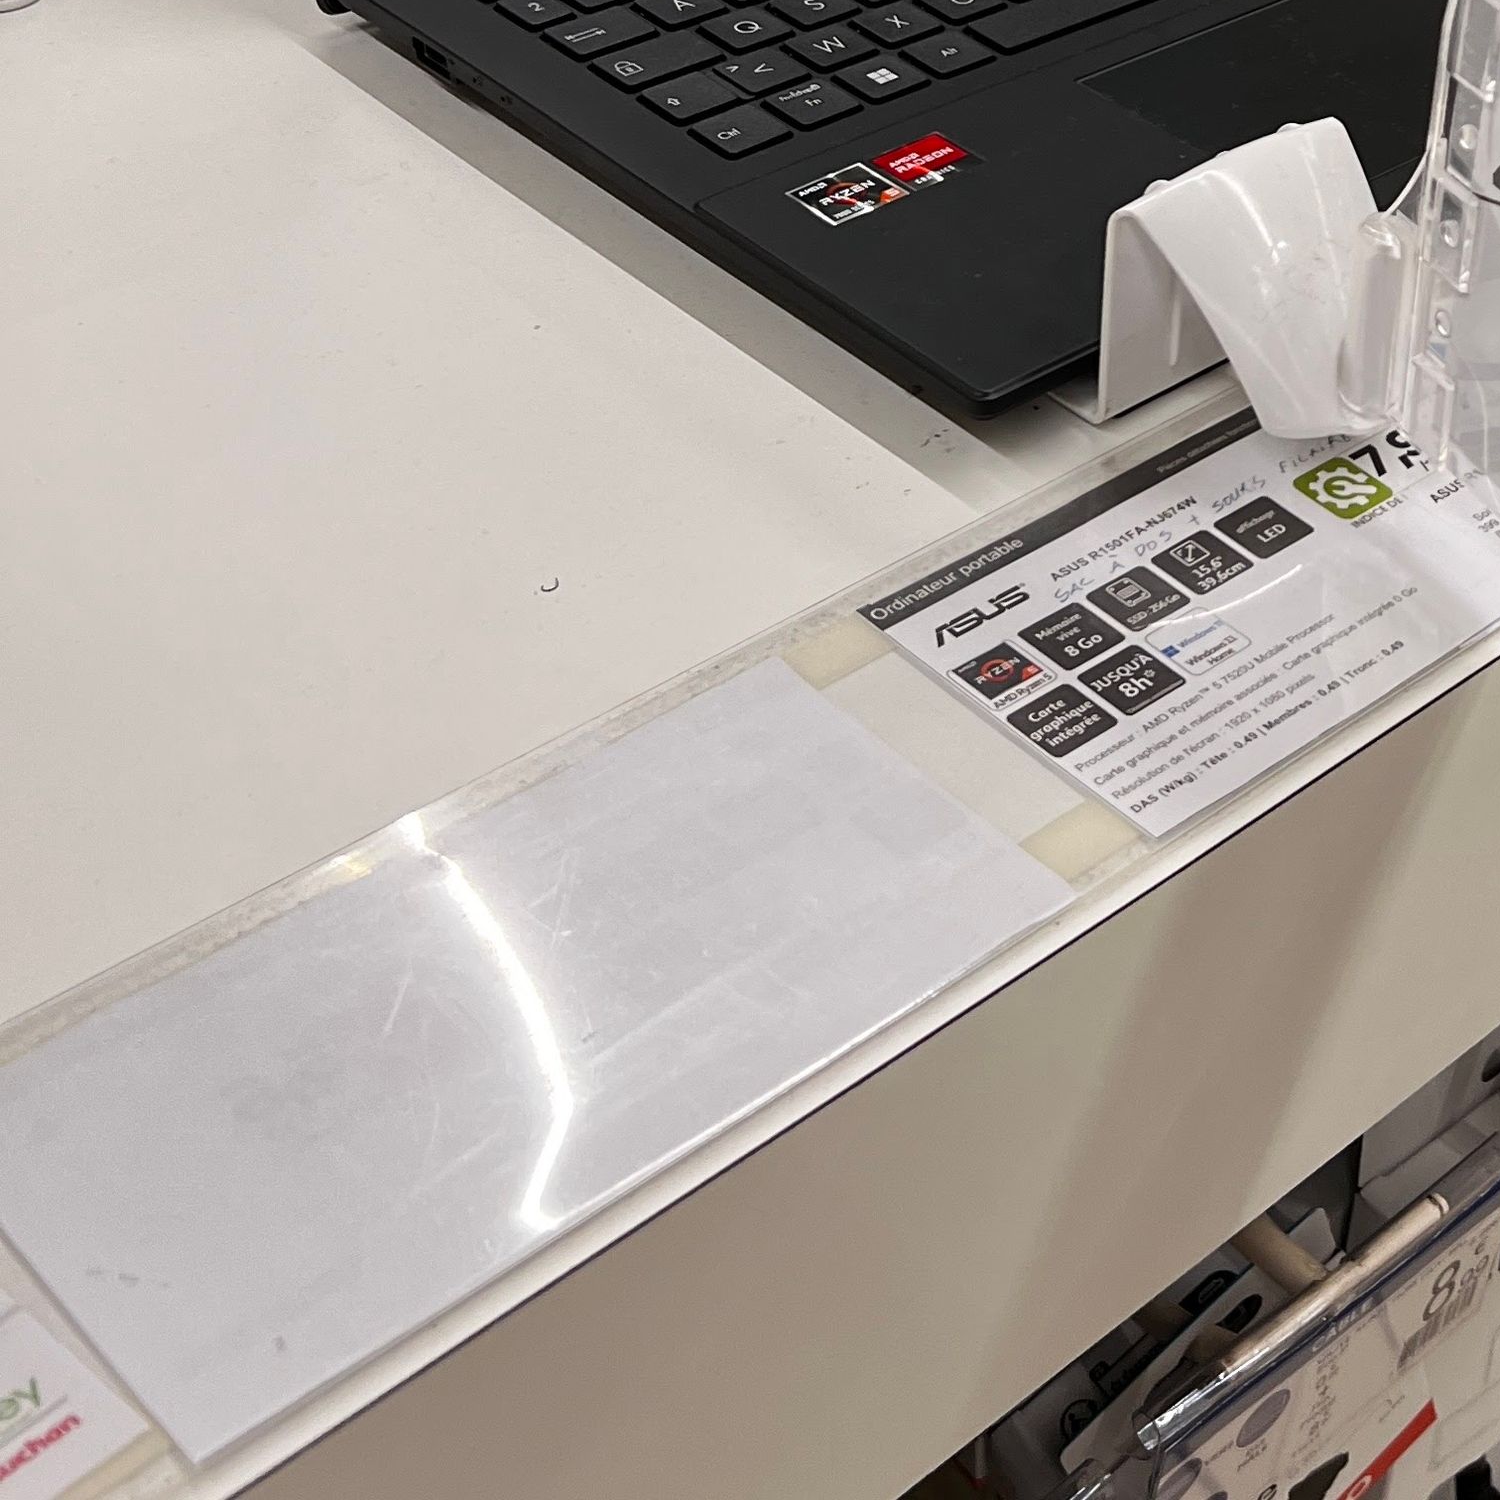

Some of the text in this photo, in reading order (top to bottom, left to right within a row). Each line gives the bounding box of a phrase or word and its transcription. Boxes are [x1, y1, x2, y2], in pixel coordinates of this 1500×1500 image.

[893, 146, 955, 174] RADEON
[798, 181, 828, 198] AMD
[818, 179, 877, 207] RYZEN
[1256, 522, 1287, 544] LED
[1350, 503, 1389, 530] INDICE
[1050, 495, 1198, 583] ASUS R1501FA-NJ674W
[869, 537, 1025, 621] Ordinateur portable
[1053, 575, 1096, 603] SAC
[1134, 529, 1173, 557] DOS
[1197, 561, 1248, 594] 39,6cm
[934, 582, 1031, 648] ASUS
[1034, 612, 1083, 641] Mémoire
[1055, 625, 1082, 643] vive
[1063, 633, 1104, 659] 8 Go
[1184, 638, 1223, 668] Windows
[1207, 647, 1235, 666] Home
[974, 655, 1022, 685] RYZEN
[1089, 651, 1155, 693] JUSQU'À
[993, 691, 1017, 710] AMD
[1015, 676, 1044, 698] Ryzen
[1074, 733, 1136, 773] Processeur
[1142, 712, 1170, 734] AMD
[1253, 642, 1289, 664] Mobile
[1285, 612, 1336, 645] Processor
[1093, 763, 1126, 787] Carte
[1125, 732, 1179, 769] graphique
[1177, 724, 1192, 736] et
[1189, 698, 1236, 729] mémoire
[1282, 651, 1312, 672] Carte
[1310, 623, 1358, 656] graphique
[1027, 698, 1067, 723] Carte
[1029, 698, 1095, 743] graphique
[1045, 711, 1103, 748] intégrée
[1111, 759, 1171, 800] Résolution
[1169, 753, 1186, 767] de
[1182, 731, 1221, 756] l'écran
[1223, 711, 1253, 732] 1920
[1258, 689, 1286, 709] 1080
[1285, 672, 1316, 696] pixels
[1129, 793, 1160, 814] DAS
[1158, 770, 1199, 798] (W/kg)
[1200, 750, 1229, 770] Tête
[1261, 698, 1314, 731] Membres
[1344, 657, 1378, 680] Tronc
